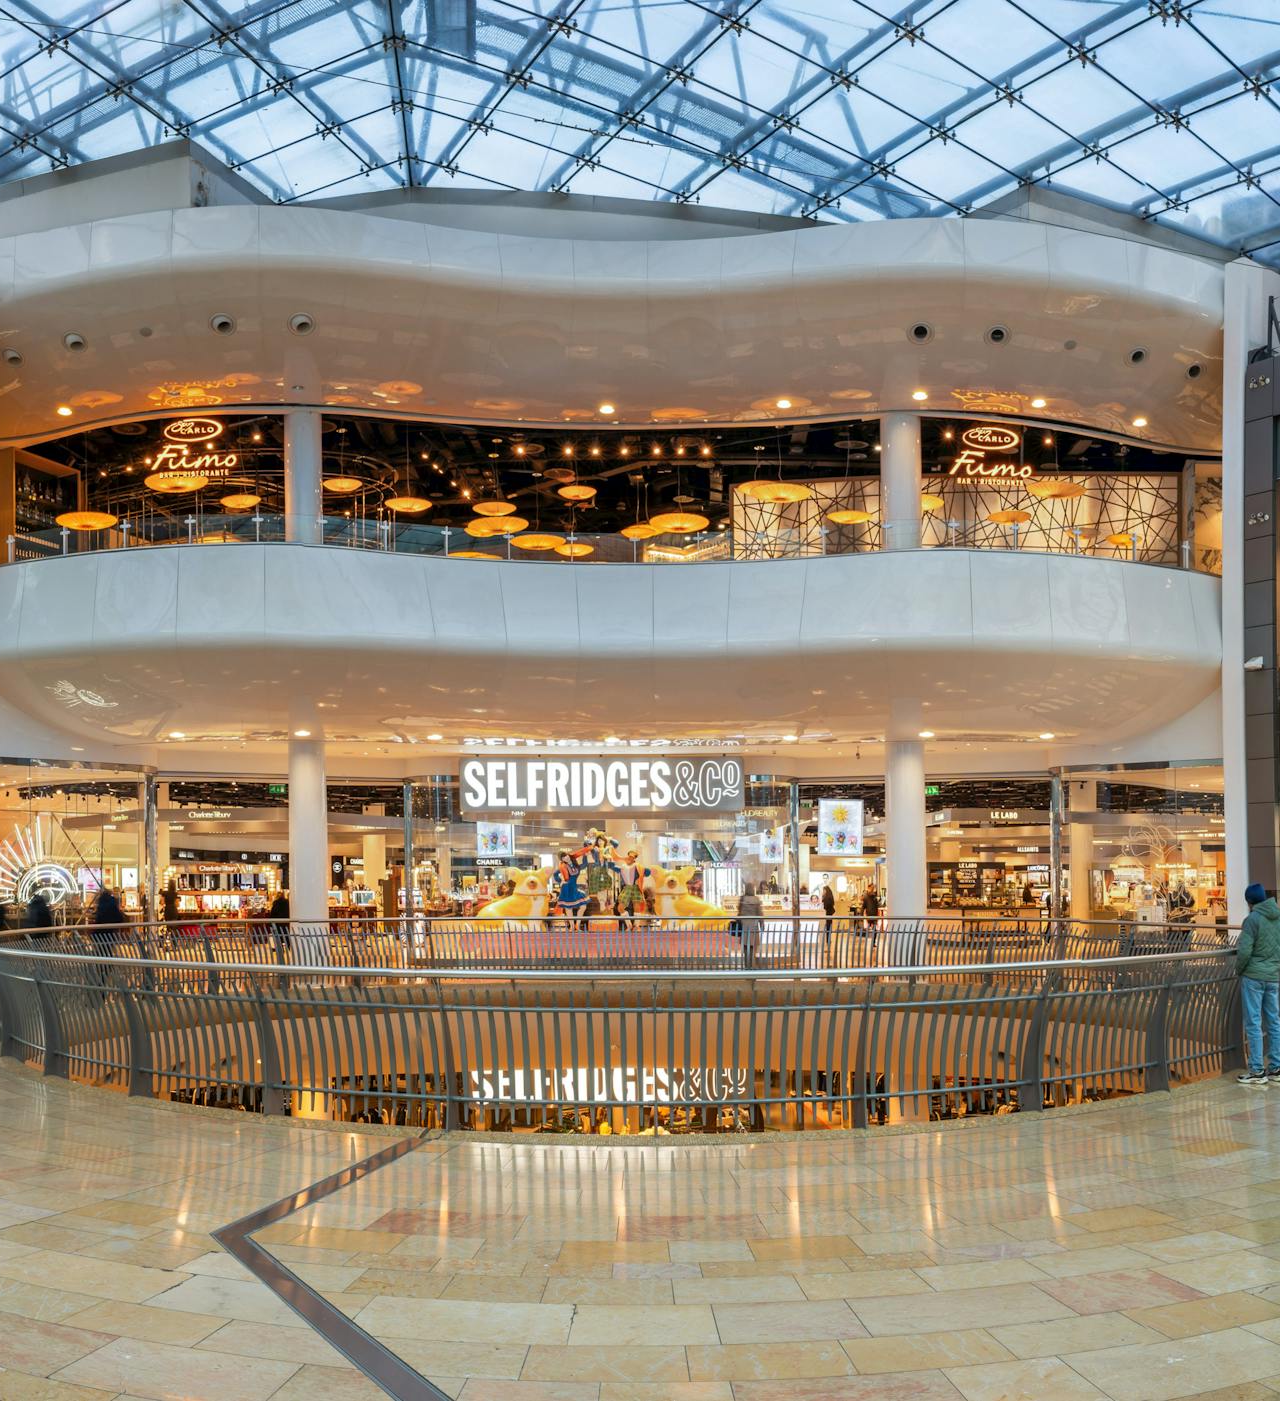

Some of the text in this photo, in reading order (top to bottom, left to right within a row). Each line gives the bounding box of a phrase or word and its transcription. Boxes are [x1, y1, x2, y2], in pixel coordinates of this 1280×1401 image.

[151, 444, 237, 470] Fumo
[949, 450, 1032, 478] Fumo
[980, 478, 1024, 486] RISTORANTE
[188, 811, 232, 820] Charlotte Tilbury
[476, 858, 503, 866] CHANEL
